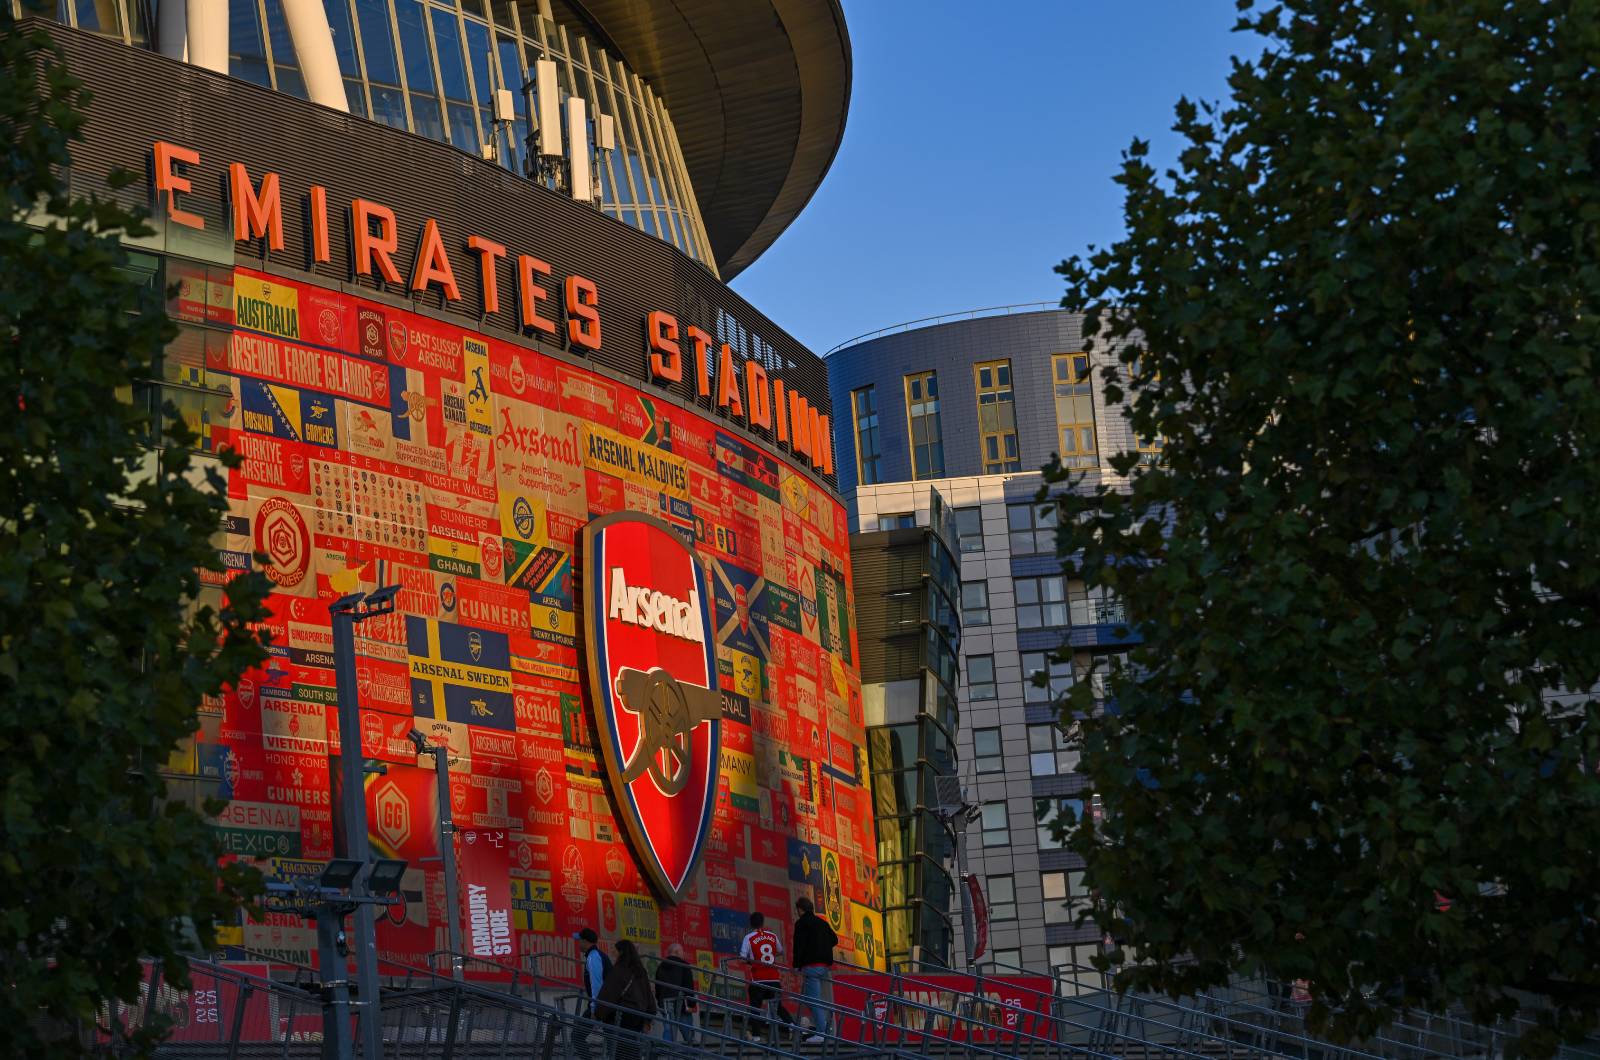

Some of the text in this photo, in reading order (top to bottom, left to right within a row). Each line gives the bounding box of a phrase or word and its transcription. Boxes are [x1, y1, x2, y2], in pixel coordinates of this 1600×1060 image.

[153, 140, 833, 475] EMIRATES STADIUM
[237, 295, 299, 338] AUSTRALIA
[410, 331, 461, 356] EAST SUSSEX
[228, 334, 372, 400] ARSENAL FAROE ISLANDS
[418, 351, 457, 373] ARSENAL
[496, 406, 581, 468] Arsenal
[240, 458, 286, 486] ARSENAL
[590, 432, 685, 490] ARSENAL MALDIVES
[425, 473, 459, 489] NORTH
[463, 482, 496, 500] WALES
[440, 510, 488, 530] GUNNERS
[431, 525, 479, 543] ARSENAL
[437, 558, 473, 575] GHANA
[460, 598, 528, 629] GUNNERS
[610, 567, 704, 643] Arsenal
[305, 653, 335, 665] ARSENA
[413, 662, 510, 687] ARSENAL SWEDEN
[298, 688, 324, 700] SOUTH
[264, 700, 324, 716] ARSENAL
[515, 695, 561, 725] Kerala
[721, 694, 746, 718] ENAL
[266, 736, 325, 753] VIETNAM
[265, 753, 328, 769] HONG KONG
[720, 753, 751, 775] MANY
[268, 786, 329, 805] GUNNERS
[218, 806, 296, 828] RSENAL
[247, 911, 304, 929] ASENAL
[468, 884, 493, 956] ARMOURY
[489, 909, 512, 956] STORE
[760, 944, 774, 965] 8
[1006, 999, 1021, 1011] 25
